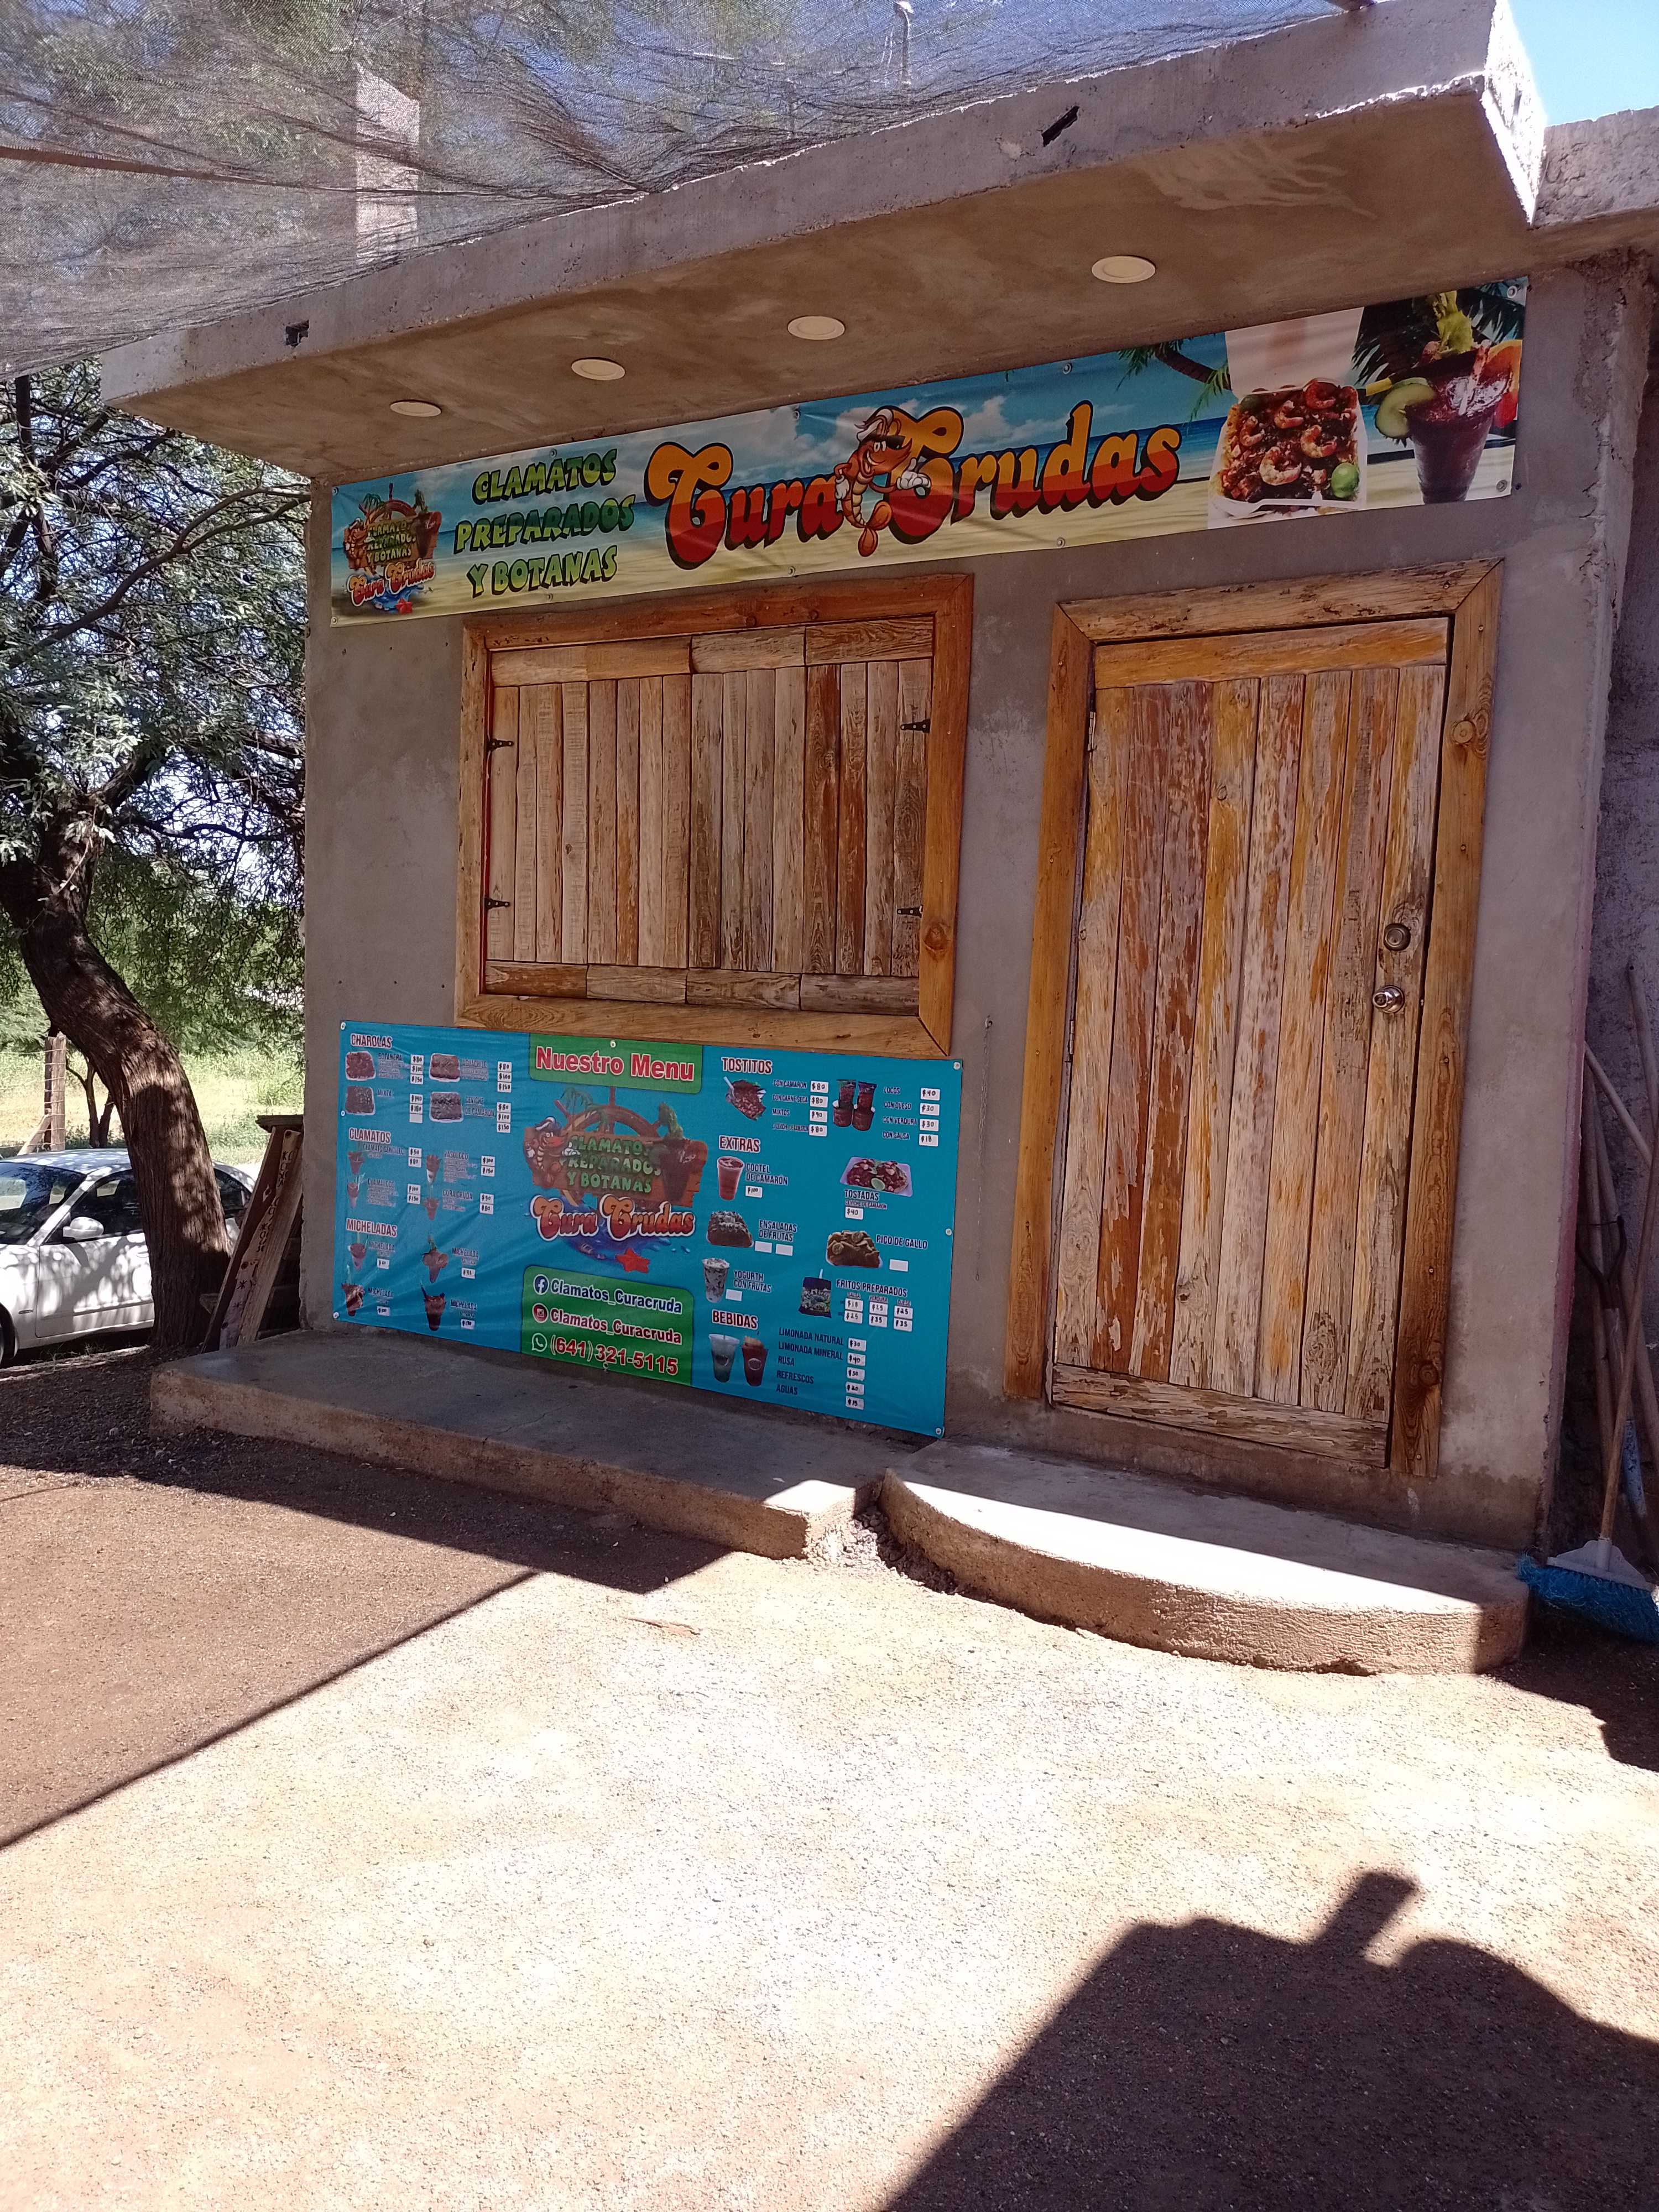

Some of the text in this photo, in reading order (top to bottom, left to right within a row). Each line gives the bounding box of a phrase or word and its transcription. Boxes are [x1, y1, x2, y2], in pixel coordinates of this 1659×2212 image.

[472, 448, 617, 505] CLAMATOS
[645, 400, 1181, 570] Cura Crudas
[368, 520, 410, 536] CLAMATO
[453, 494, 636, 555] PREPARADOS
[366, 548, 411, 563] Y BOTANAS
[467, 545, 617, 598] Y BOTANAS
[347, 558, 436, 607] Cura Crudas
[351, 1033, 392, 1048] CHAROLAS
[378, 1052, 403, 1061] BOTANERA
[462, 1058, 487, 1068] AGUACHILE
[535, 1046, 695, 1082] Nuestro Menu
[721, 1057, 773, 1074] TOSTITOS
[811, 1082, 825, 1091] $80
[922, 1089, 936, 1097] $40
[465, 1096, 484, 1105] CEVICHE
[895, 1102, 911, 1110] QUESO
[921, 1104, 934, 1113] $30
[894, 1117, 917, 1125] VERDURA
[921, 1120, 935, 1129] $30
[348, 1127, 391, 1144] CLAMATOS
[363, 1143, 383, 1152] CLAMATO
[570, 1135, 650, 1155] CLAMATO
[718, 1135, 761, 1153] EXTRAS
[746, 1162, 770, 1173] COCTEL
[566, 1170, 651, 1193] Y BOTANAS
[746, 1173, 788, 1186] DE CAMARÓN
[844, 1189, 880, 1201] TOSTADAS
[530, 1193, 696, 1241] Cura Crudas
[346, 1218, 398, 1238] MICHELADAS
[759, 1219, 797, 1233] ENSALADAS
[759, 1230, 794, 1242] DE FRUTAS
[876, 1234, 928, 1249] PICO DE GALLO
[368, 1240, 395, 1251] MICHELADA
[452, 1247, 479, 1259] MICHELADA
[734, 1270, 764, 1281] YOGURTH
[368, 1287, 393, 1298] MICHELADA
[734, 1279, 771, 1293] CON FRUTAS
[836, 1278, 907, 1297] FRITOS PREPARADOS
[550, 1278, 683, 1315] Clamatos_Curacruda
[451, 1299, 477, 1311] MICHELADA
[712, 1309, 759, 1329] BEBIDAS
[550, 1308, 682, 1345] Clamatos_Curacruda
[779, 1327, 844, 1346] LIMONADA NATURAL
[550, 1334, 679, 1375] (641) 321-5115
[778, 1341, 843, 1360] LIMONADA MINERAL
[778, 1355, 795, 1366] RUSA
[776, 1370, 814, 1384] REFRESCOS
[776, 1384, 798, 1395] AGUAS
